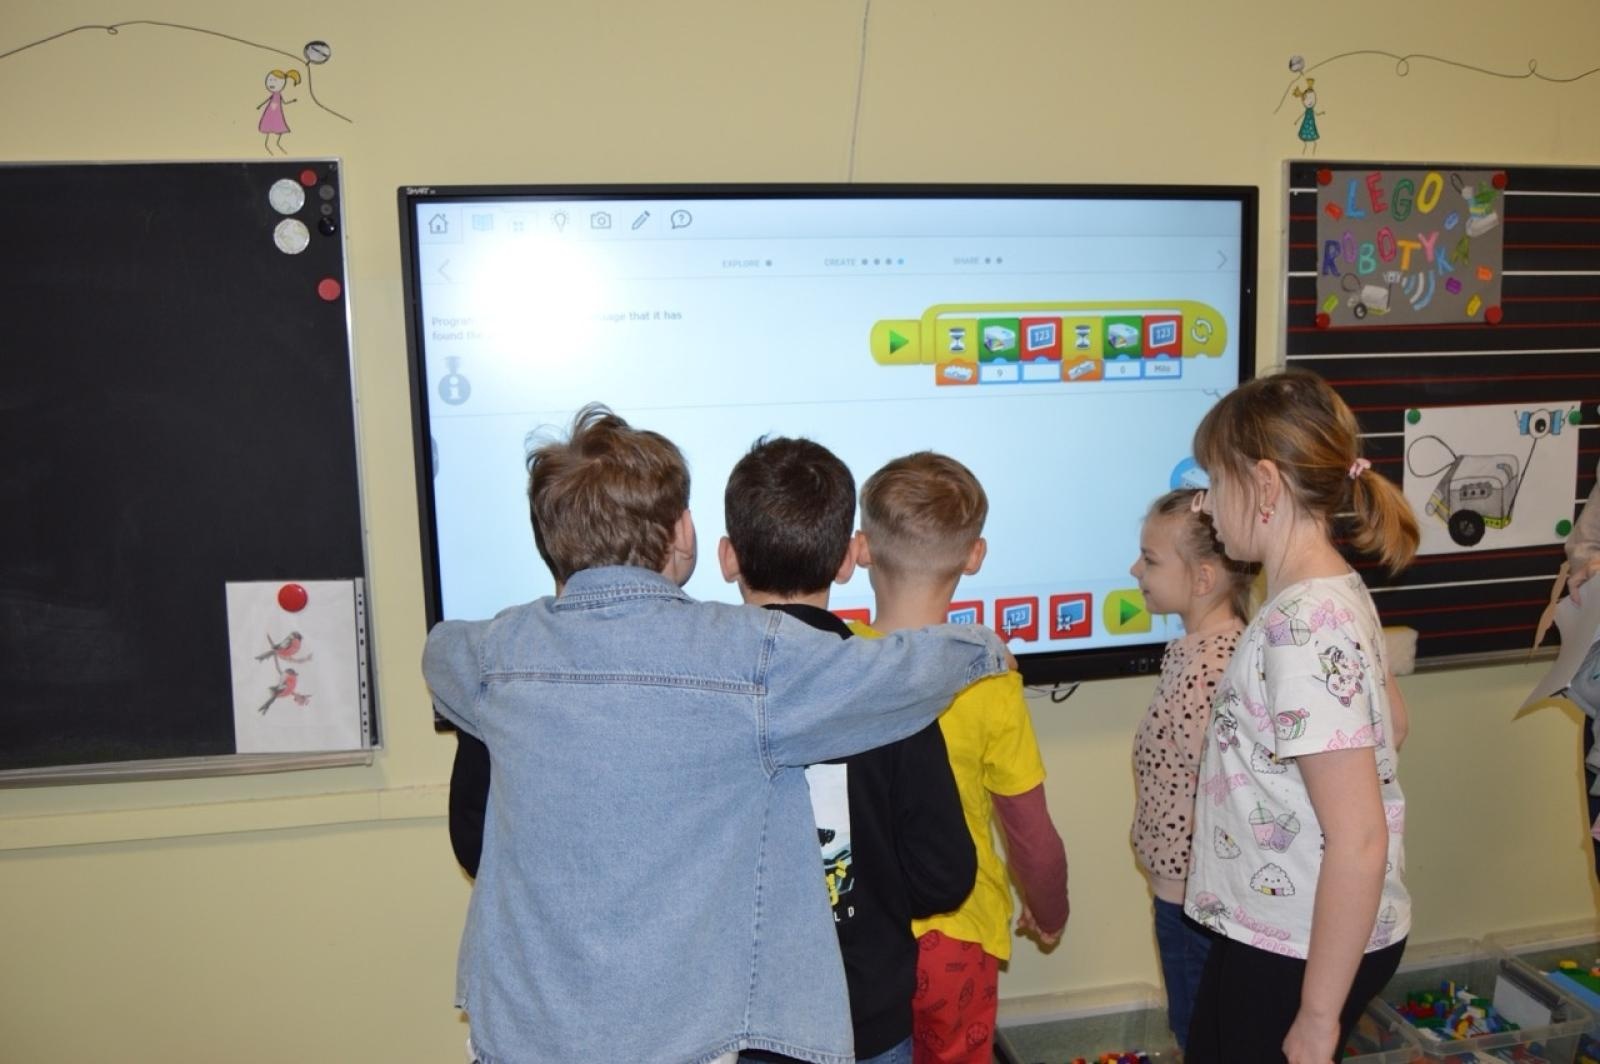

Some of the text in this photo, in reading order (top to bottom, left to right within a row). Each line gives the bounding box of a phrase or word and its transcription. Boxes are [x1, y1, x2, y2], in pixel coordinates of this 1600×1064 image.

[1345, 172, 1444, 222] LEGO
[1322, 226, 1470, 277] ROBOTYKA
[722, 258, 760, 269] EXPLORE
[823, 257, 856, 267] CREATE
[953, 256, 980, 265] SHARE
[628, 311, 649, 320] that
[652, 310, 661, 320] it
[664, 309, 682, 320] has
[432, 331, 463, 340] found
